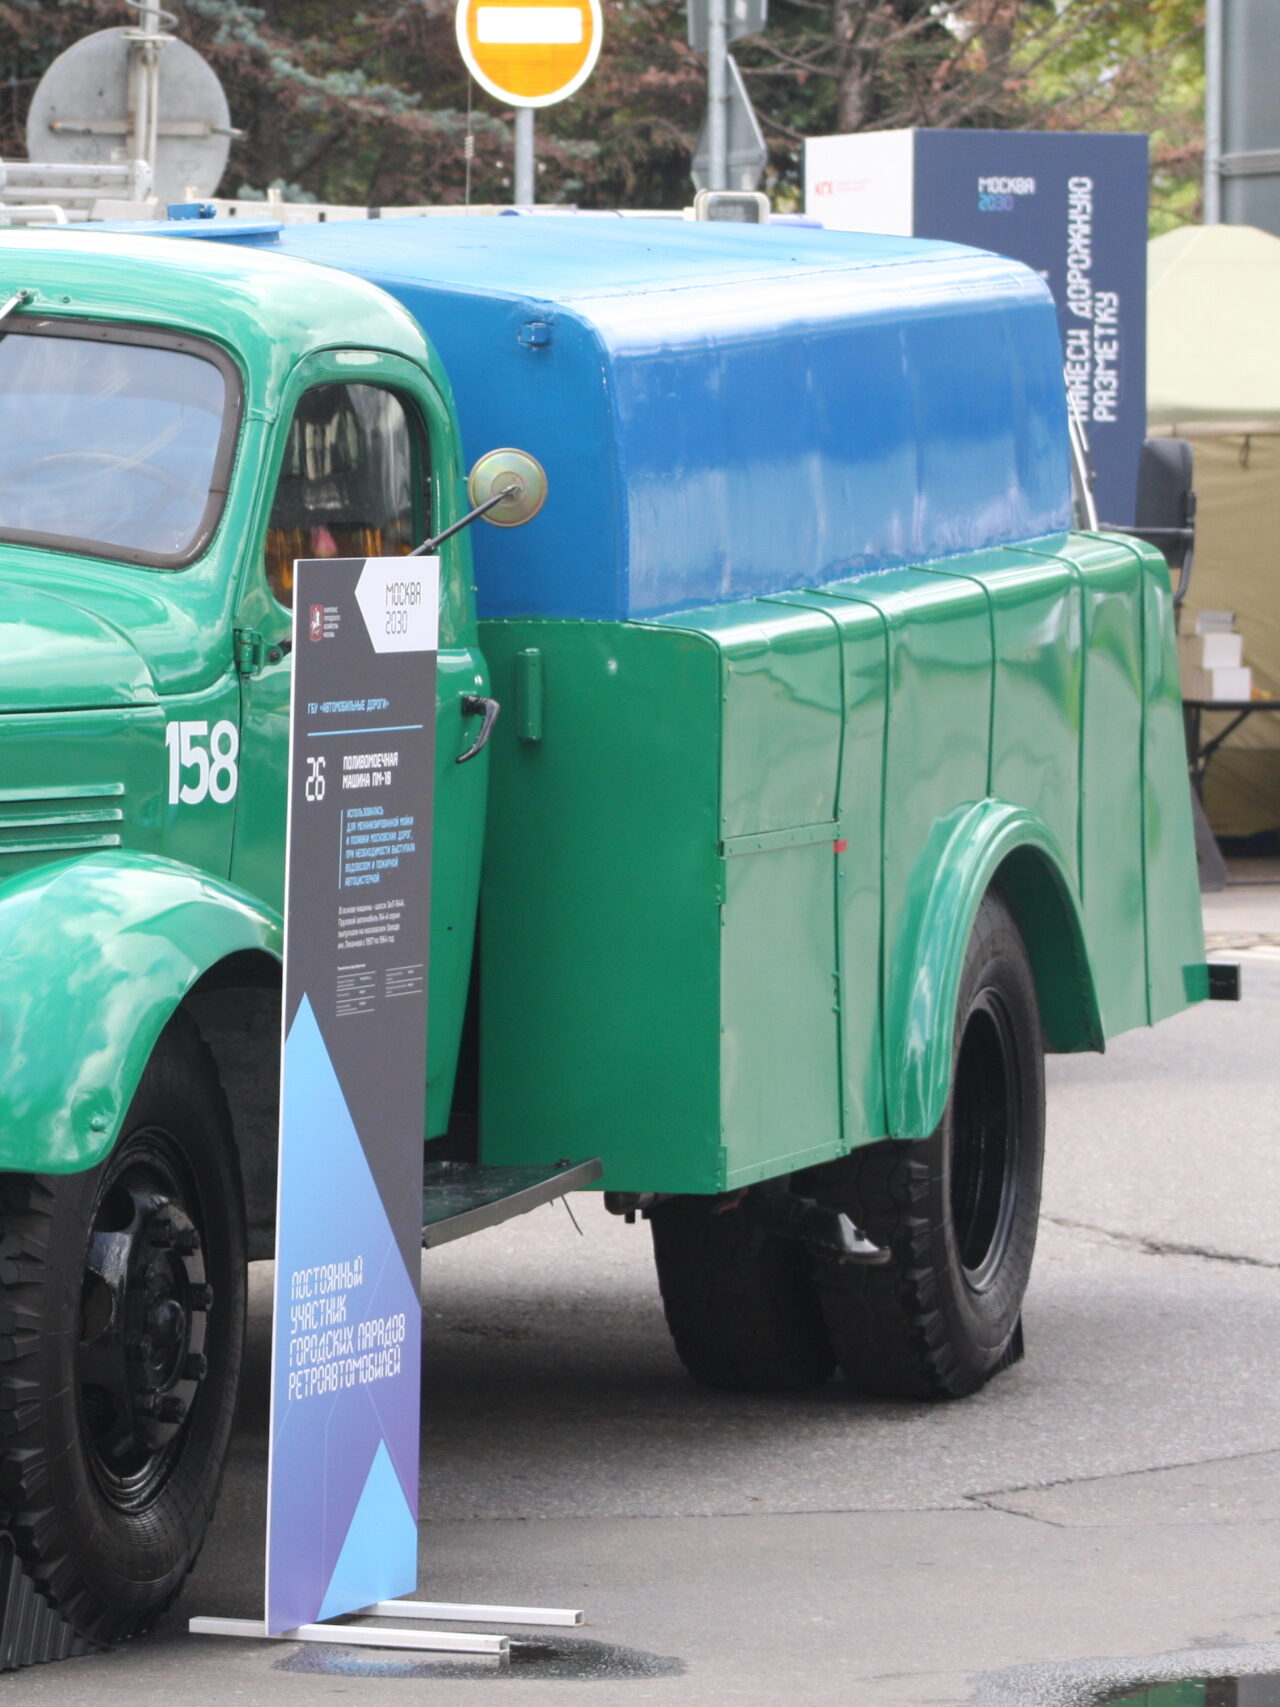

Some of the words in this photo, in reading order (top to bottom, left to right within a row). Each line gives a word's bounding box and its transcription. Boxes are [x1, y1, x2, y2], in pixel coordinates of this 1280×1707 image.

[978, 176, 1036, 195] МОСКВА
[978, 193, 1014, 212] 2030
[1067, 177, 1093, 319] ДОРОЖНУЮ
[1093, 291, 1119, 422] РАЗМЕТКУ
[386, 582, 421, 606] МОСКВА
[385, 610, 408, 635] 2030
[307, 702, 318, 714] ГБУ
[165, 720, 239, 805] 158
[305, 756, 326, 801] 26
[342, 773, 370, 789] МАШИНА
[343, 752, 398, 770] ПОЛИВОМОЕЧНАЯ
[291, 1255, 363, 1300] ПОСТОЯННЫЙ
[290, 1294, 346, 1334] УЧАСТНИК
[289, 1326, 354, 1367] ГОРОДСКИХ
[357, 1313, 405, 1351] ПАРАДОВ
[288, 1344, 401, 1400] РЕТРОАВТОМОБИЛЕЙ
